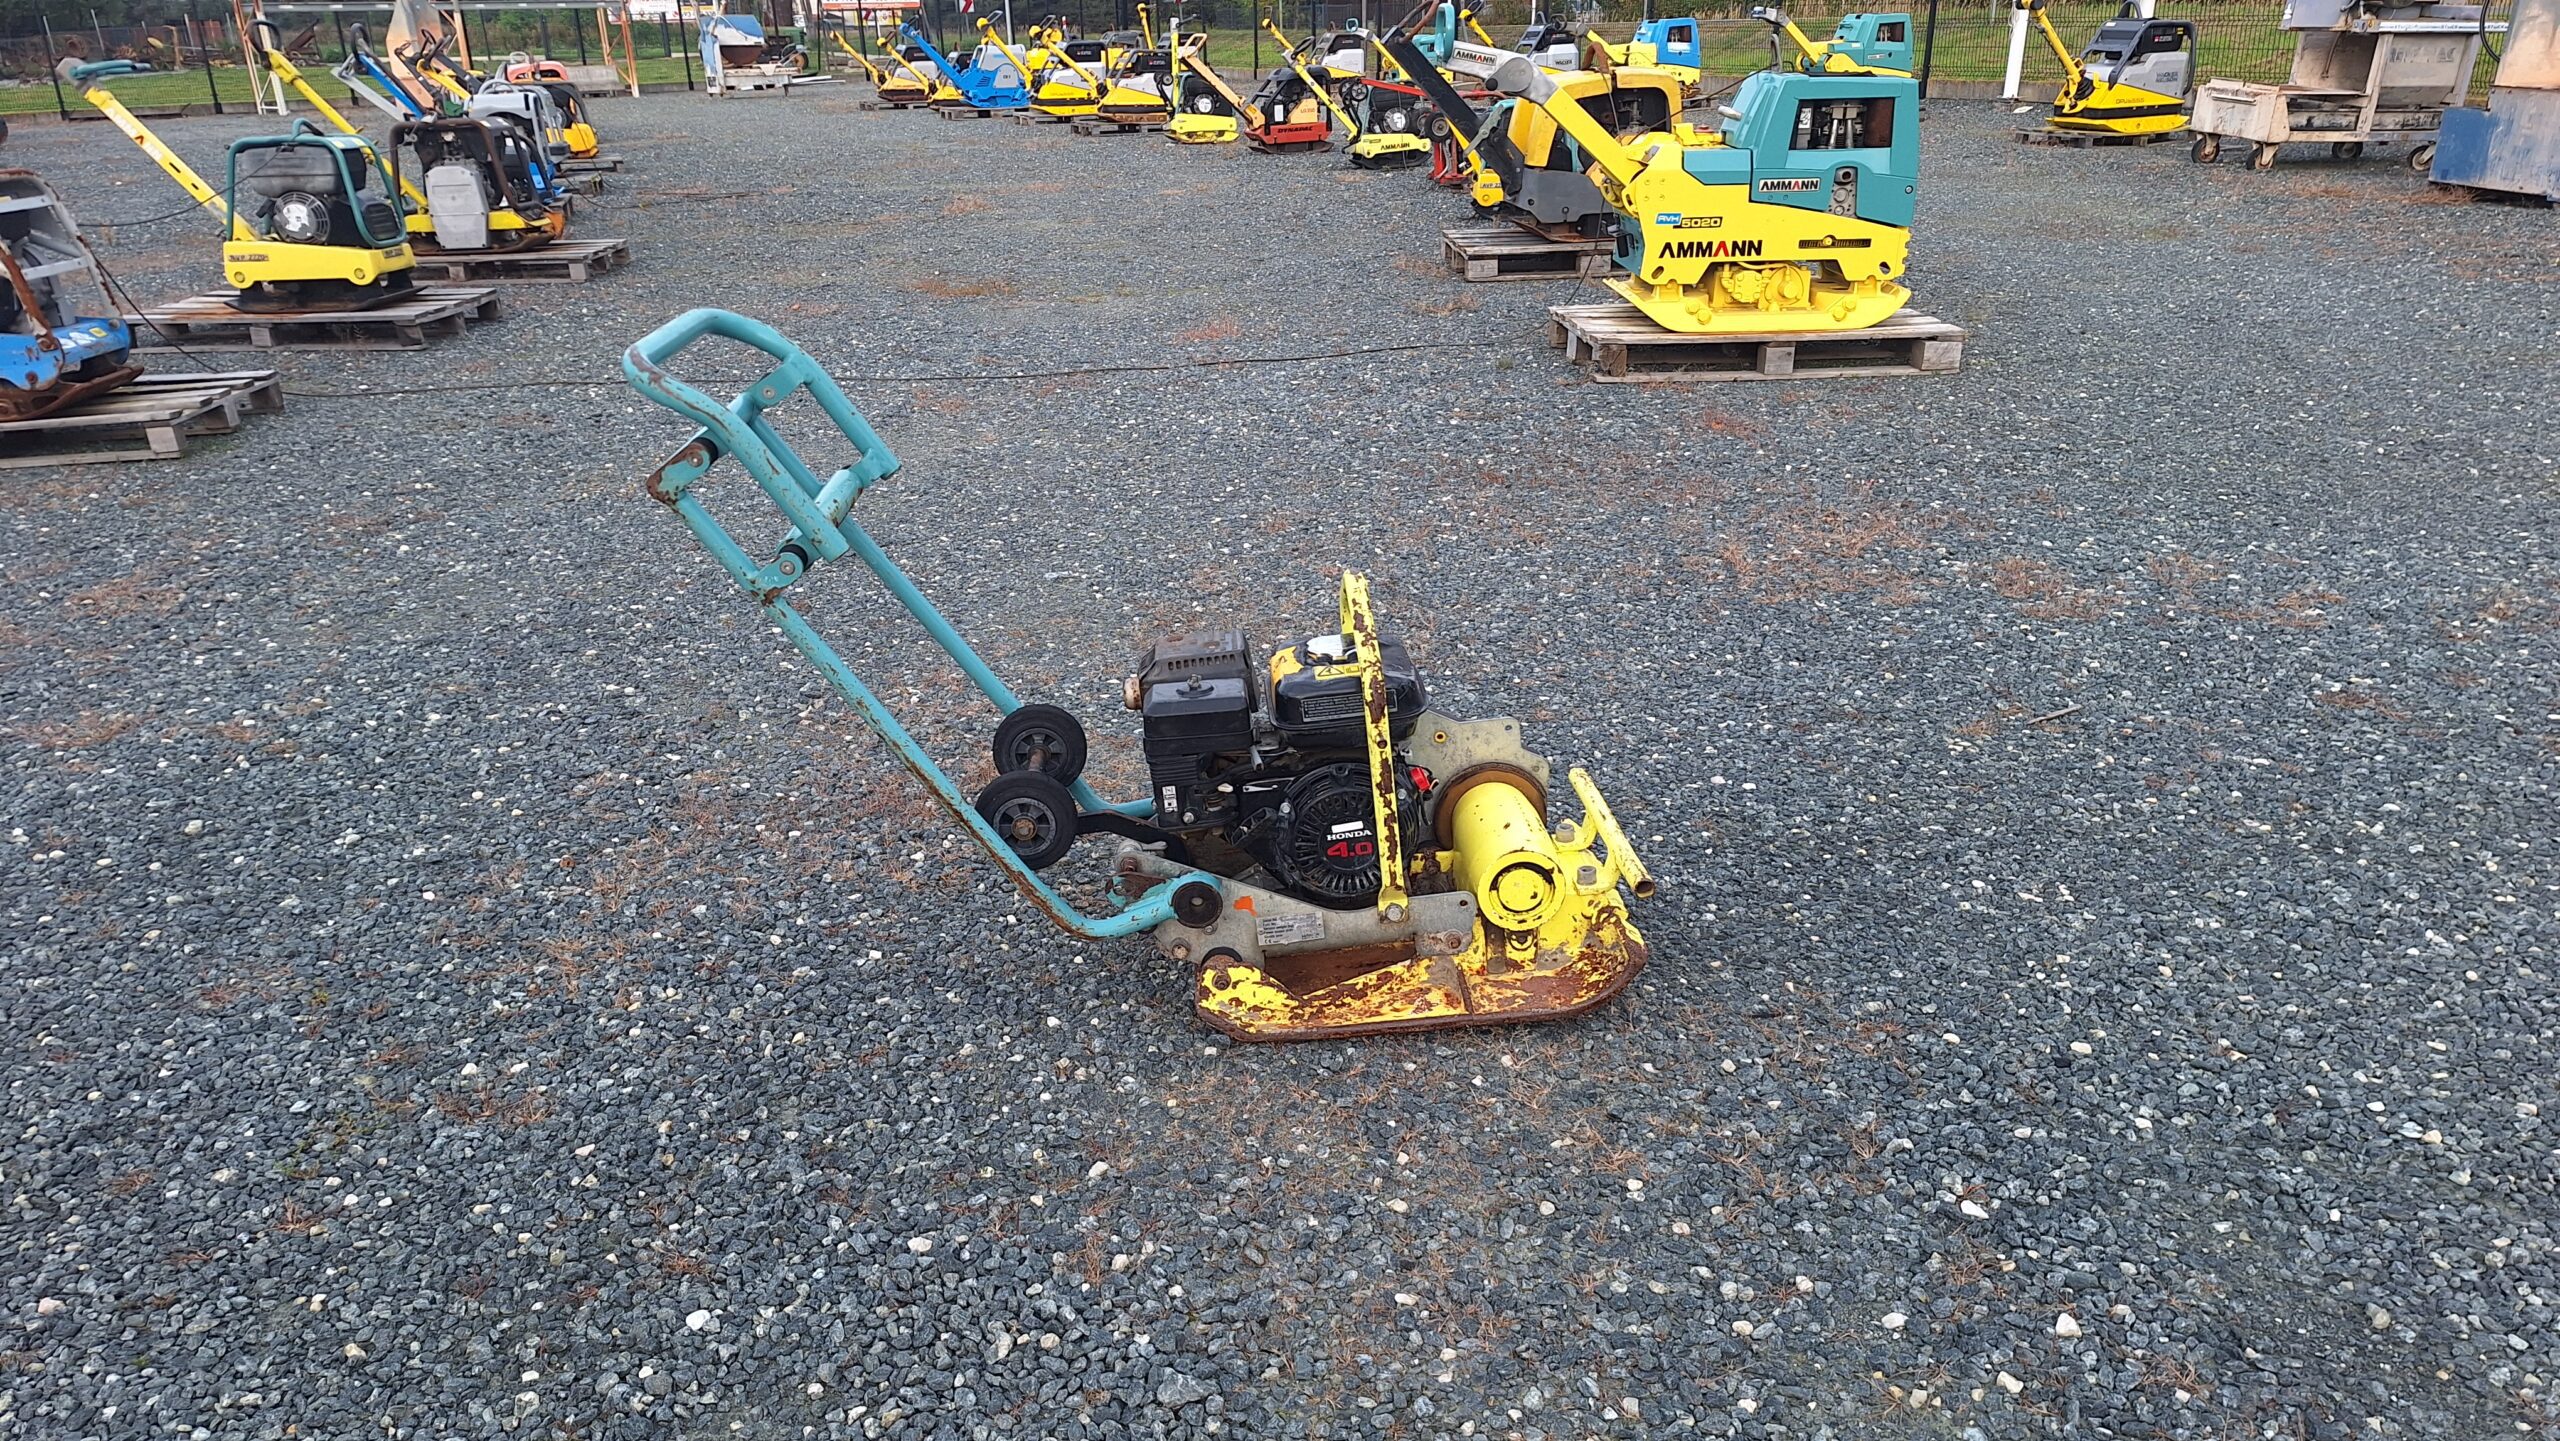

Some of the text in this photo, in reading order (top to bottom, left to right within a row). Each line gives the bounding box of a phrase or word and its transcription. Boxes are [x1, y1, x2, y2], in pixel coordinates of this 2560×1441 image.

[1455, 50, 1496, 65] AMMANN
[1380, 142, 1410, 150] AMMANN
[1760, 179, 1819, 191] AMMANN
[1681, 217, 1721, 228] 5020
[1658, 239, 1762, 258] AMMANN
[1326, 830, 1372, 841] HONDA
[1327, 841, 1373, 858] 4.0
